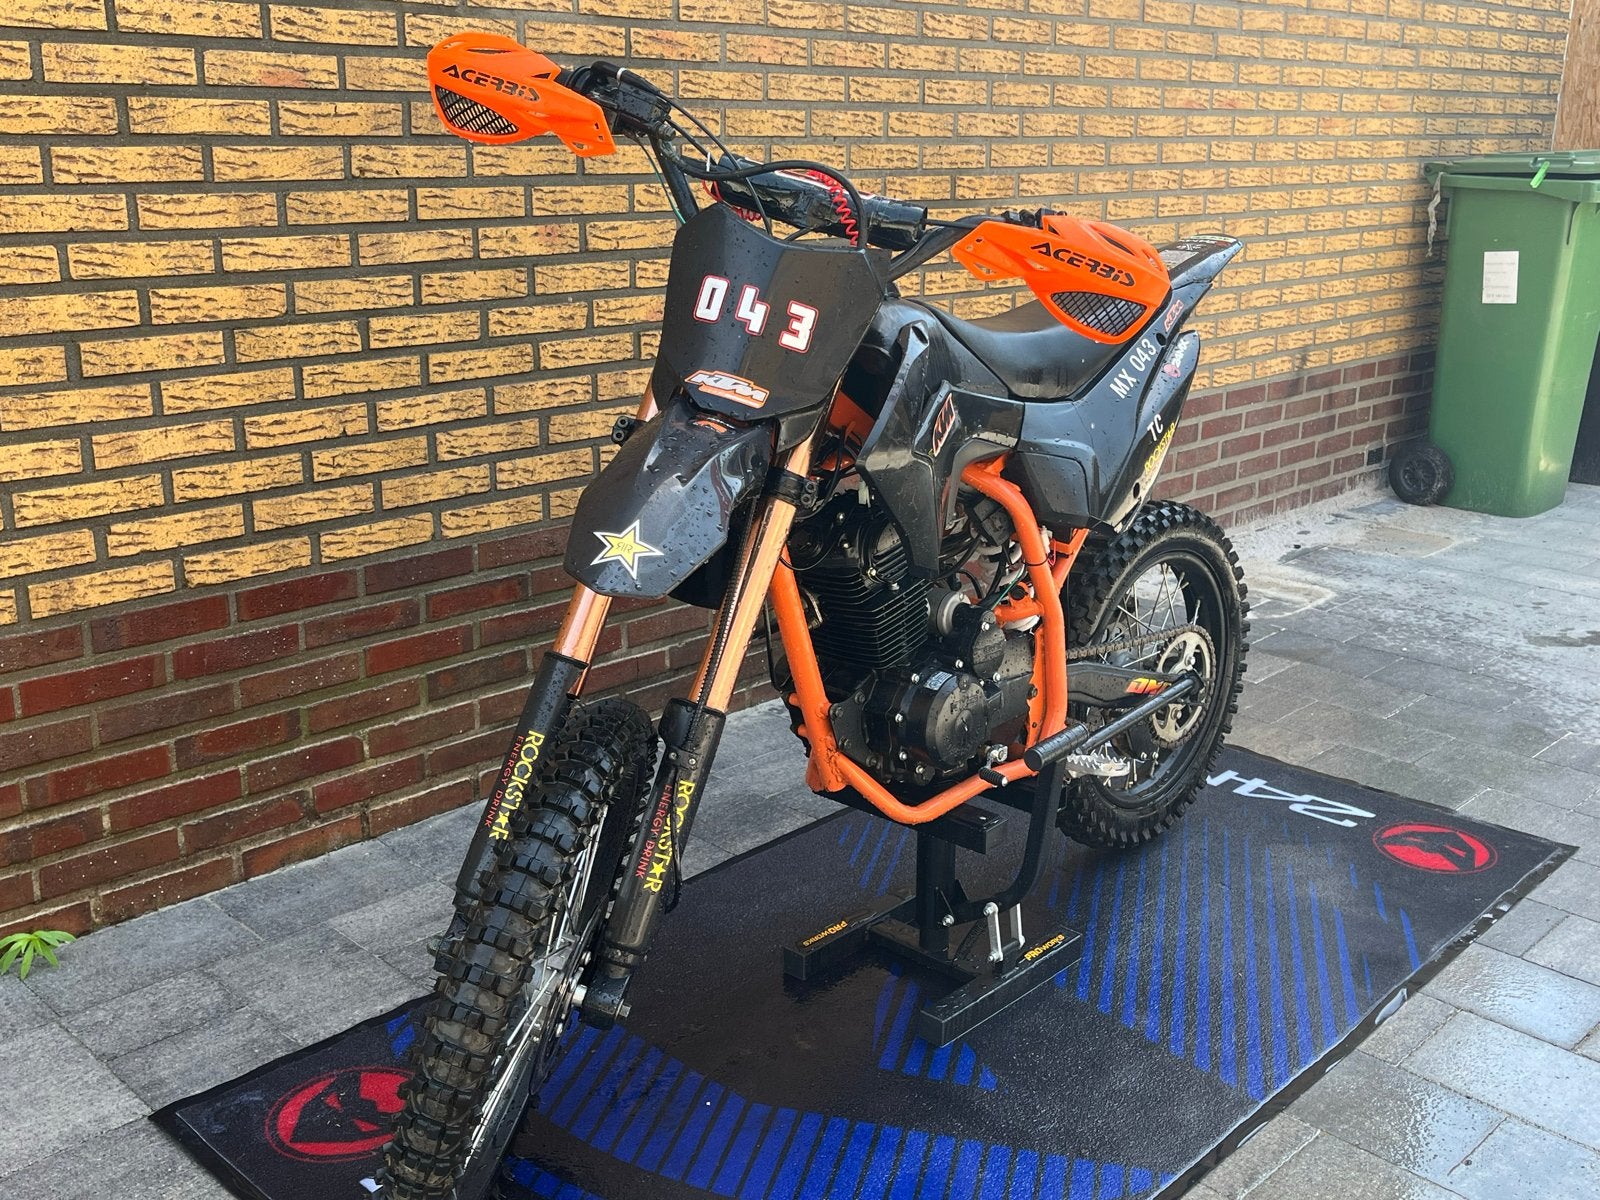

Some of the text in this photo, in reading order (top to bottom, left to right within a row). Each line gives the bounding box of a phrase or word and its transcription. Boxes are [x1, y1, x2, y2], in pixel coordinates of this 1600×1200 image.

[1030, 242, 1136, 287] ACERBIS
[687, 372, 769, 403] KTM
[1109, 338, 1157, 399] MX 043
[1147, 413, 1164, 442] TC
[484, 735, 525, 828] ENERGY DRINK
[635, 784, 673, 878] ENERGY DRINK
